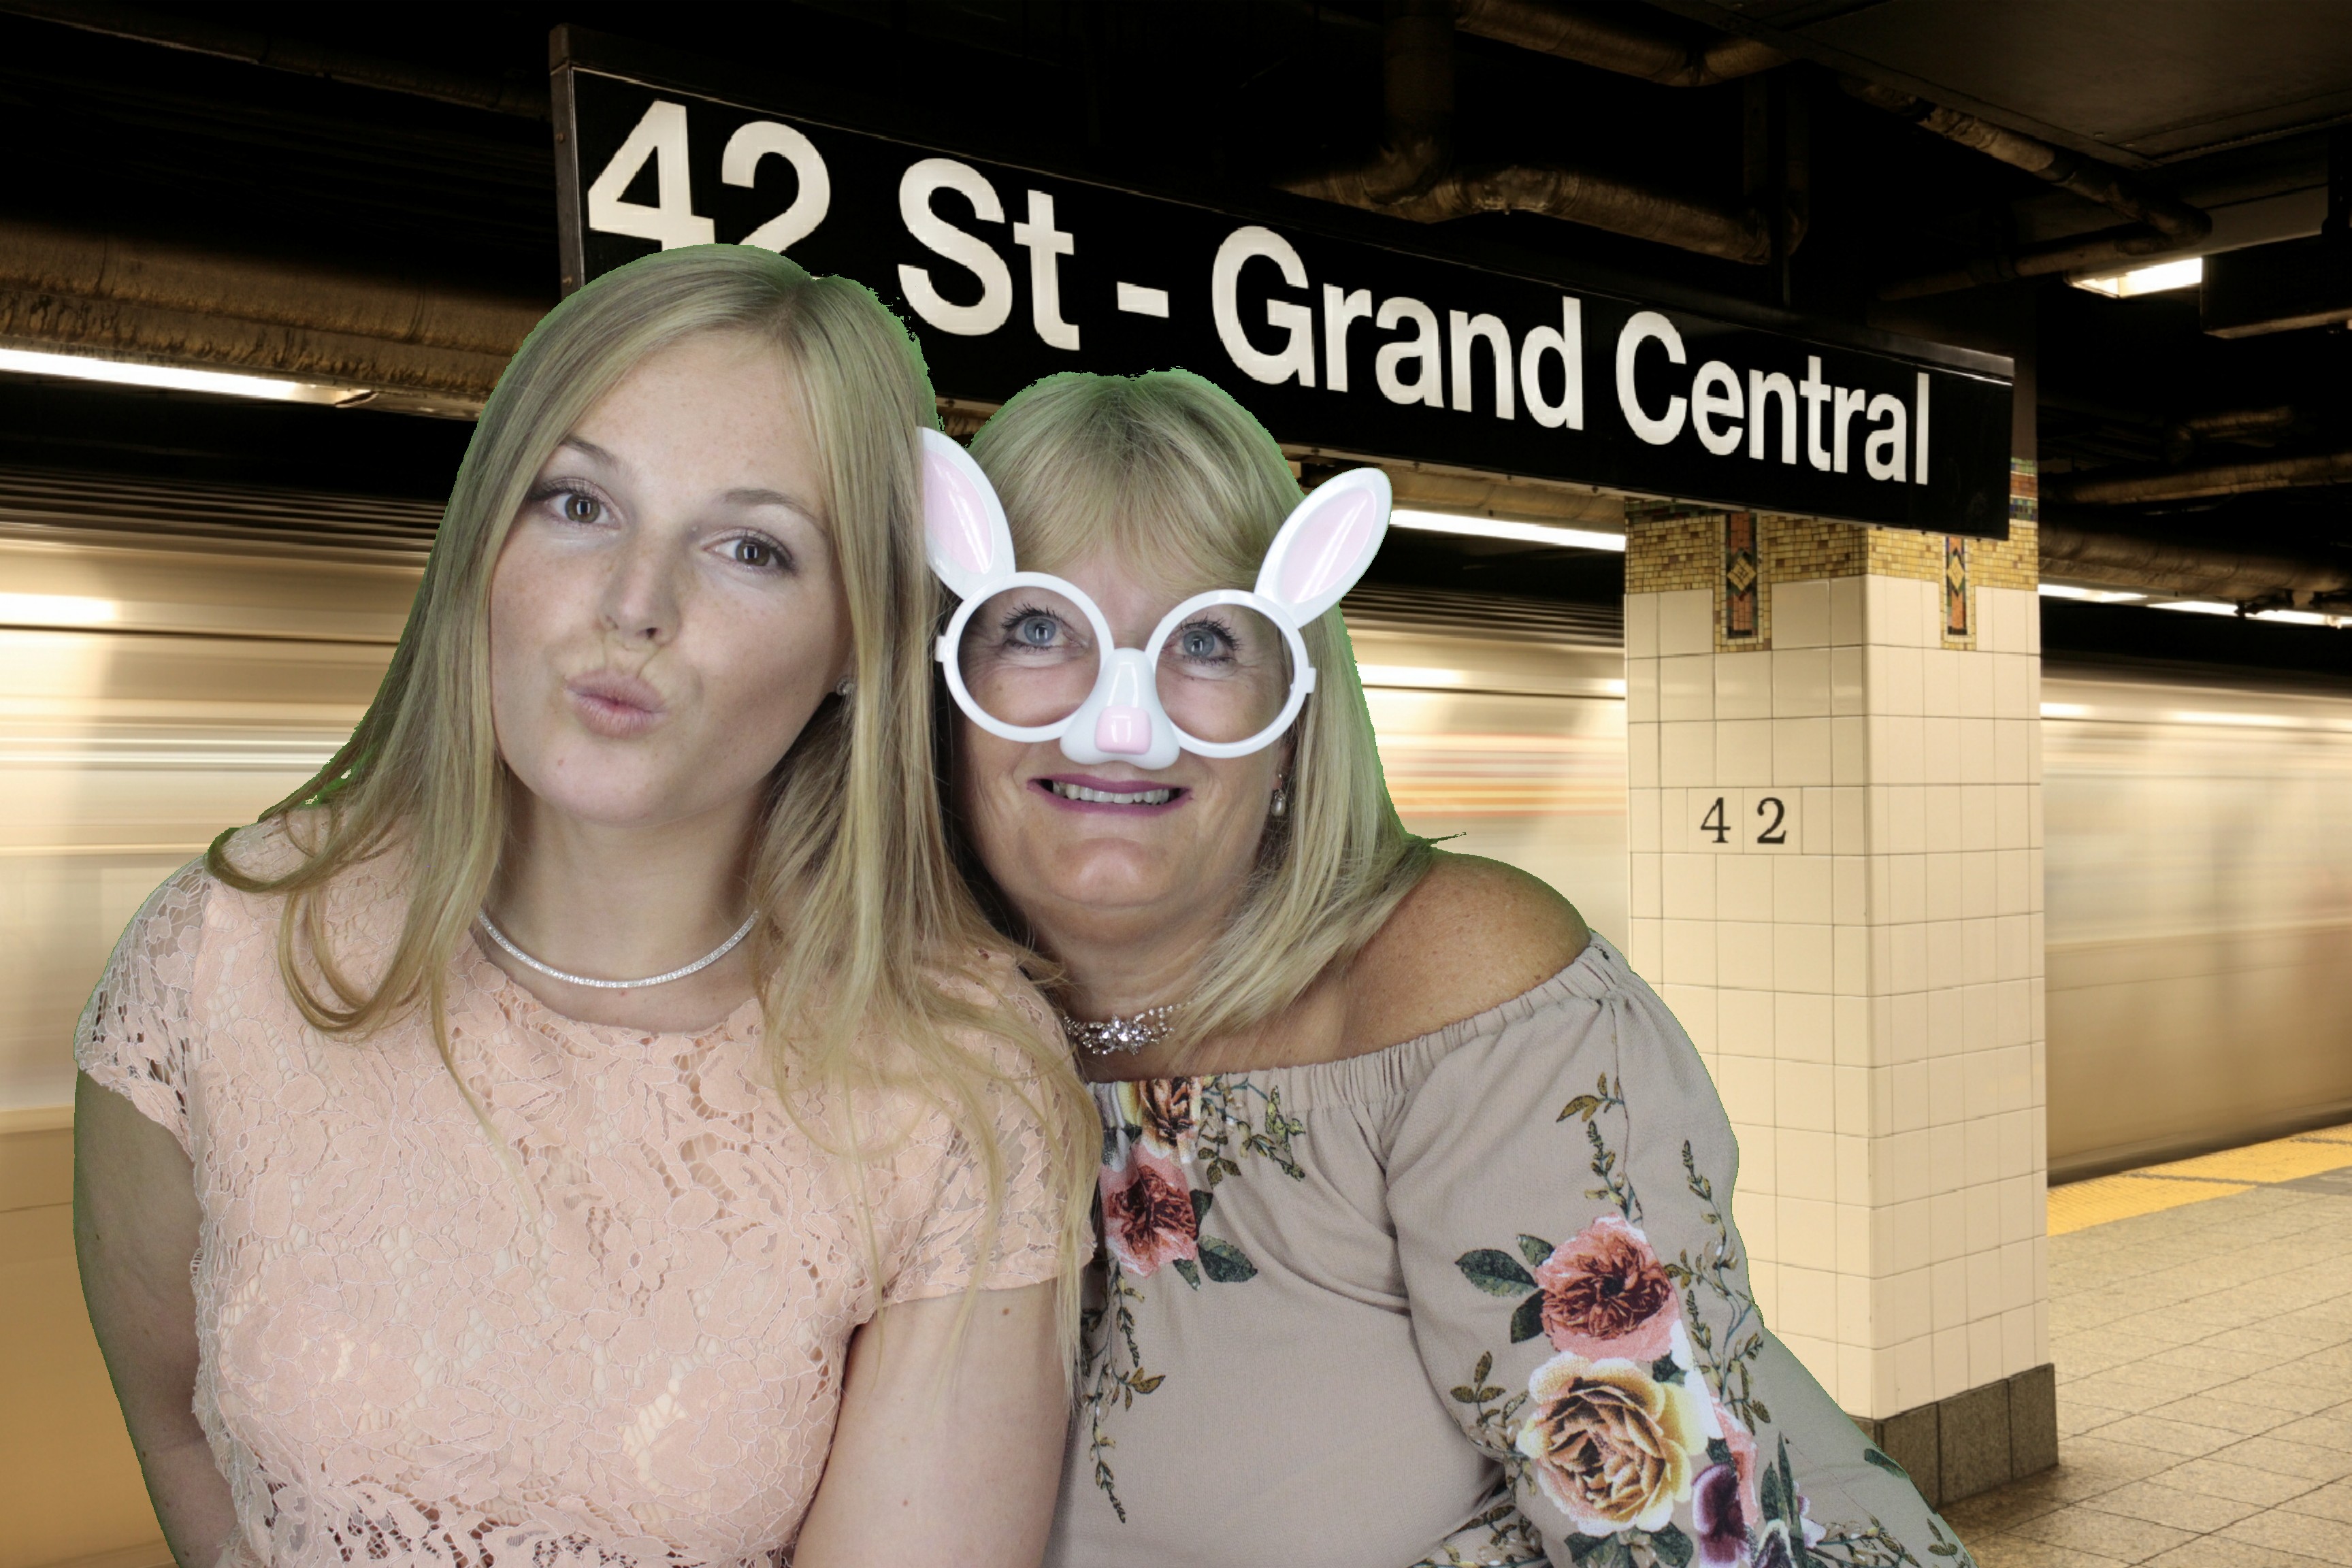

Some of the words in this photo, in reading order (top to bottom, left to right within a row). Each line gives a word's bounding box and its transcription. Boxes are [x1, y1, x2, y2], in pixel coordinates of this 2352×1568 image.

[588, 99, 831, 256] 42
[897, 157, 1080, 351] St
[1116, 281, 1170, 318] -
[1211, 225, 1584, 431] Grand
[1615, 310, 1929, 485] Central
[1700, 797, 1787, 845] 42
